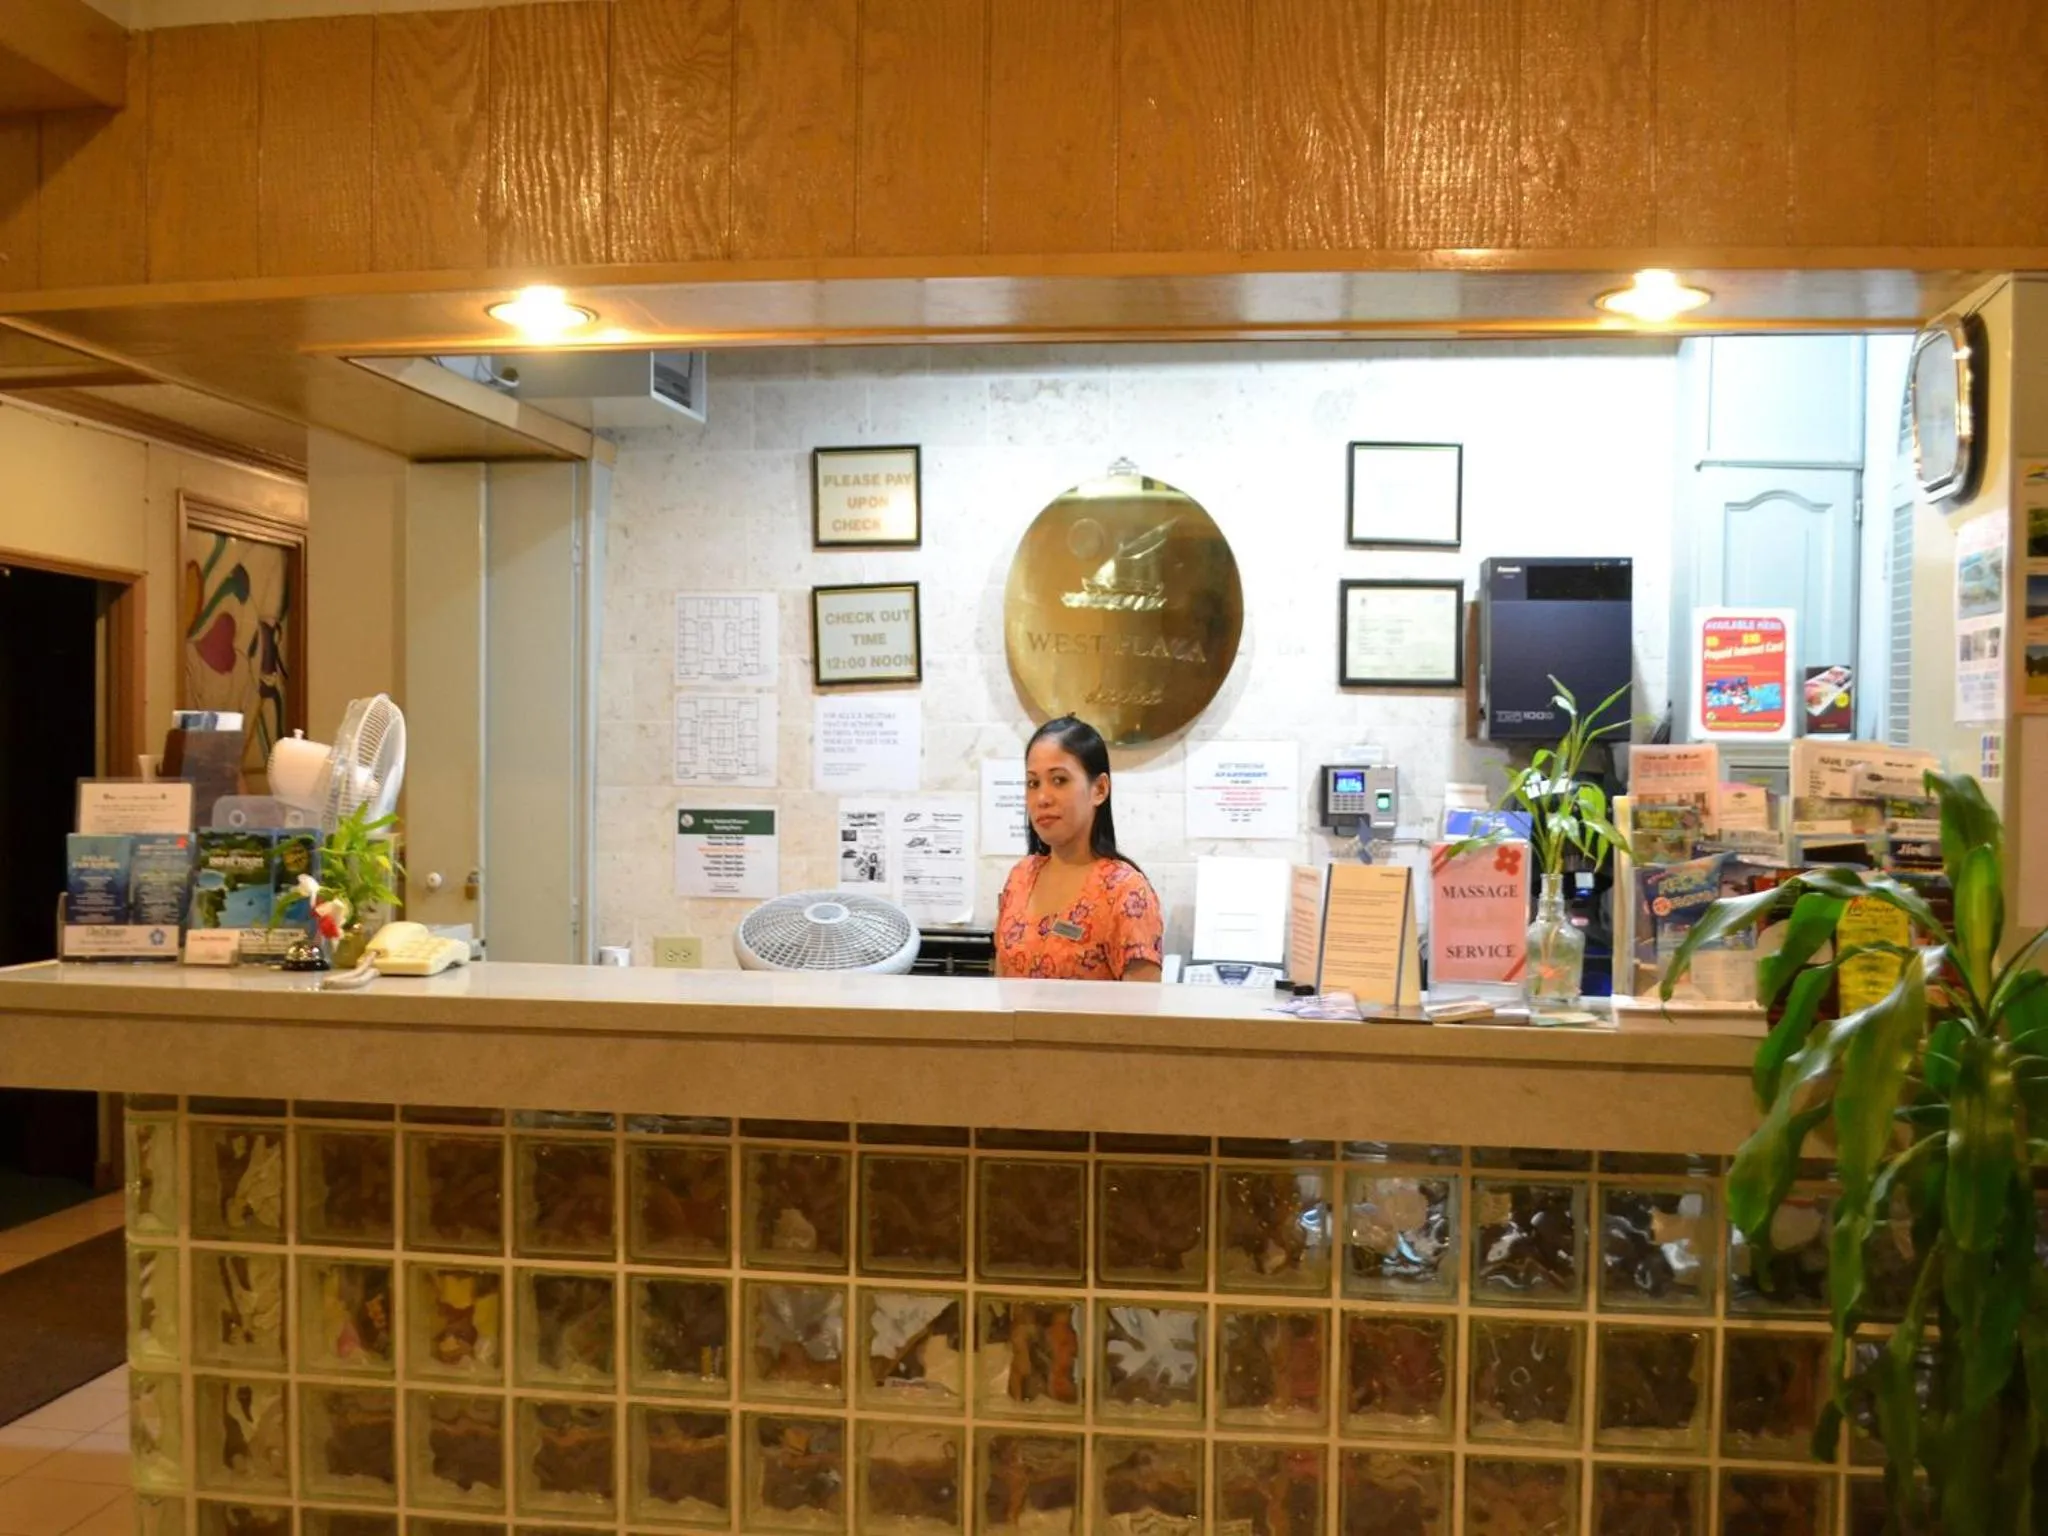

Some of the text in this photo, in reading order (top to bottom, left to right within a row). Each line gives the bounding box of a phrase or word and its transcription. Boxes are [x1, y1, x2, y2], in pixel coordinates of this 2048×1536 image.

[823, 472, 914, 488] PLEASE PAY
[847, 496, 888, 509] UPON
[825, 608, 911, 626] CHECK OUT
[851, 632, 888, 646] TIME
[1028, 631, 1207, 663] WEST PLAZA
[827, 654, 916, 670] 12:00 NOON
[1442, 884, 1519, 899] MASSAGE
[1446, 944, 1516, 959] SERVICE
